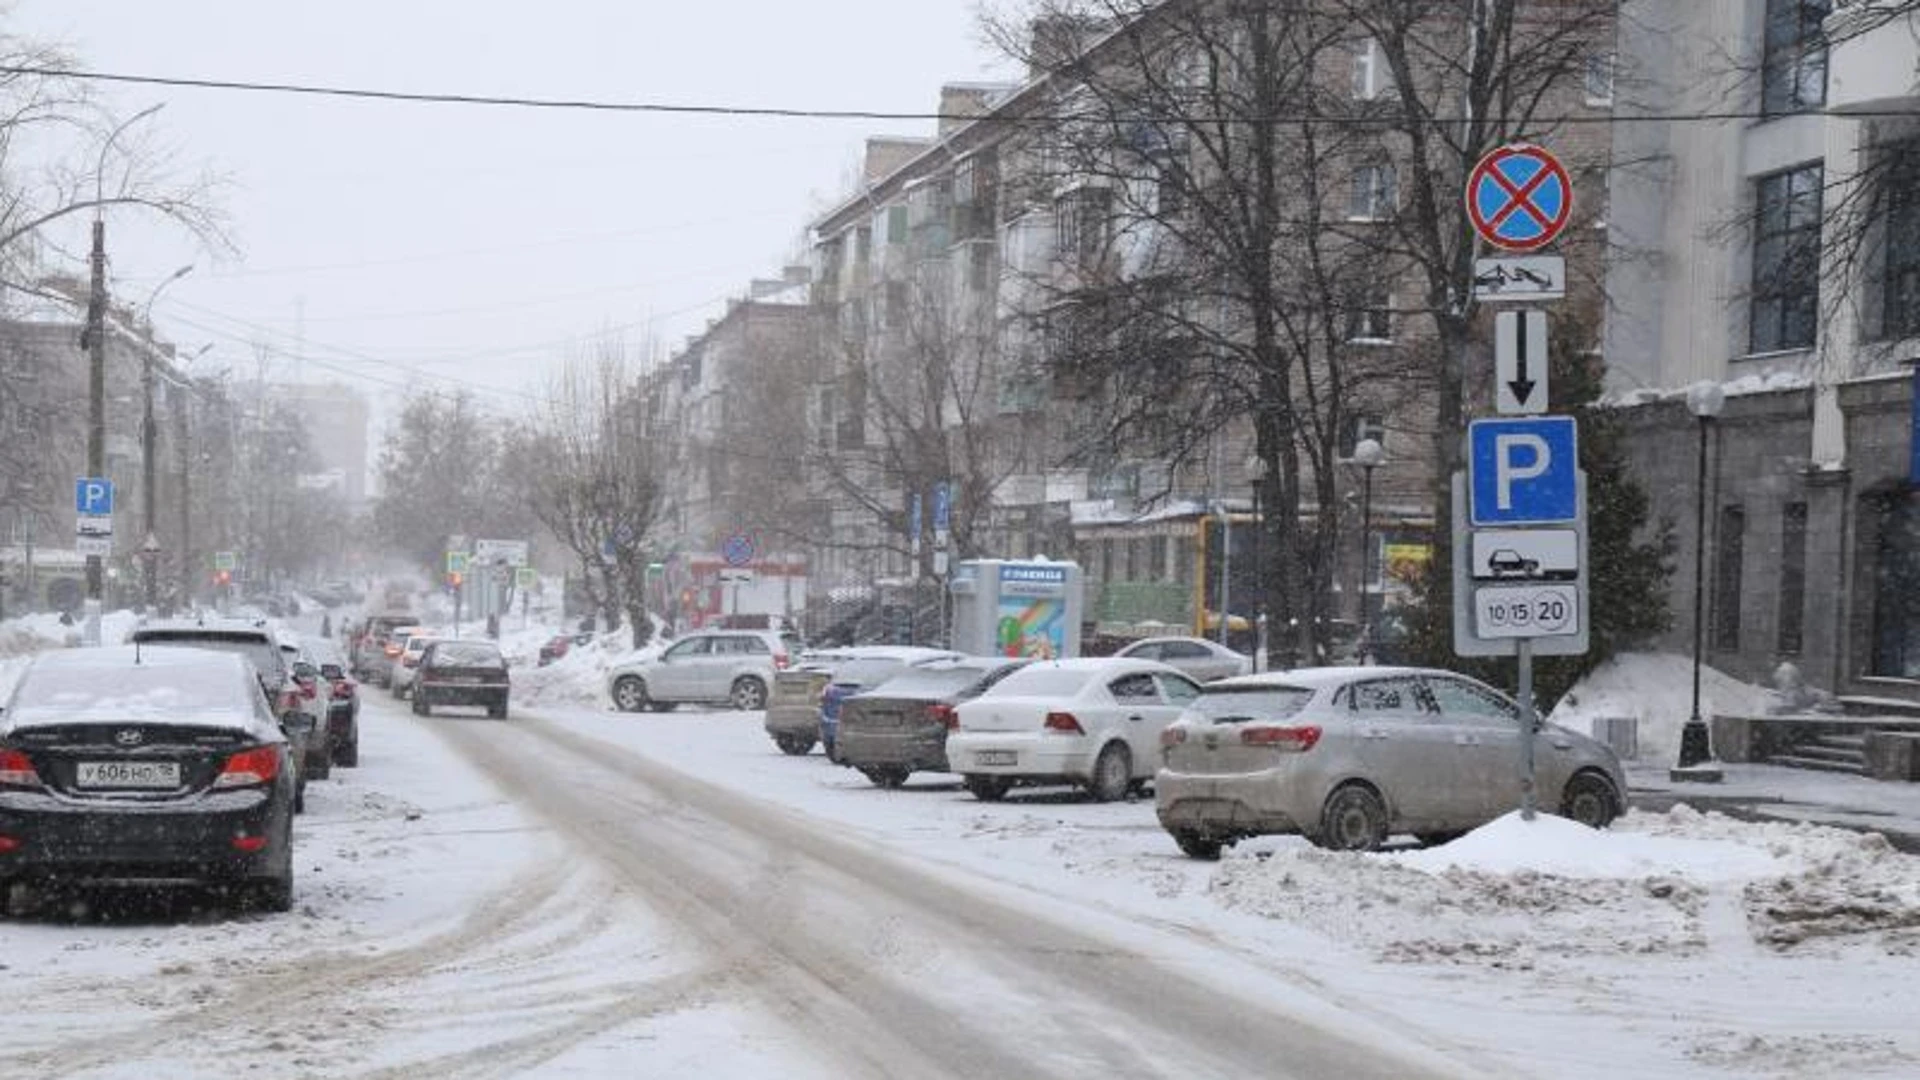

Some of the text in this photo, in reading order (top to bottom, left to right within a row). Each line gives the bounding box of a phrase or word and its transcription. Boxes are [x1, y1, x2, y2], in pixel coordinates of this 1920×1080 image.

[1496, 433, 1550, 510] P
[1488, 601, 1564, 621] 10 15 20
